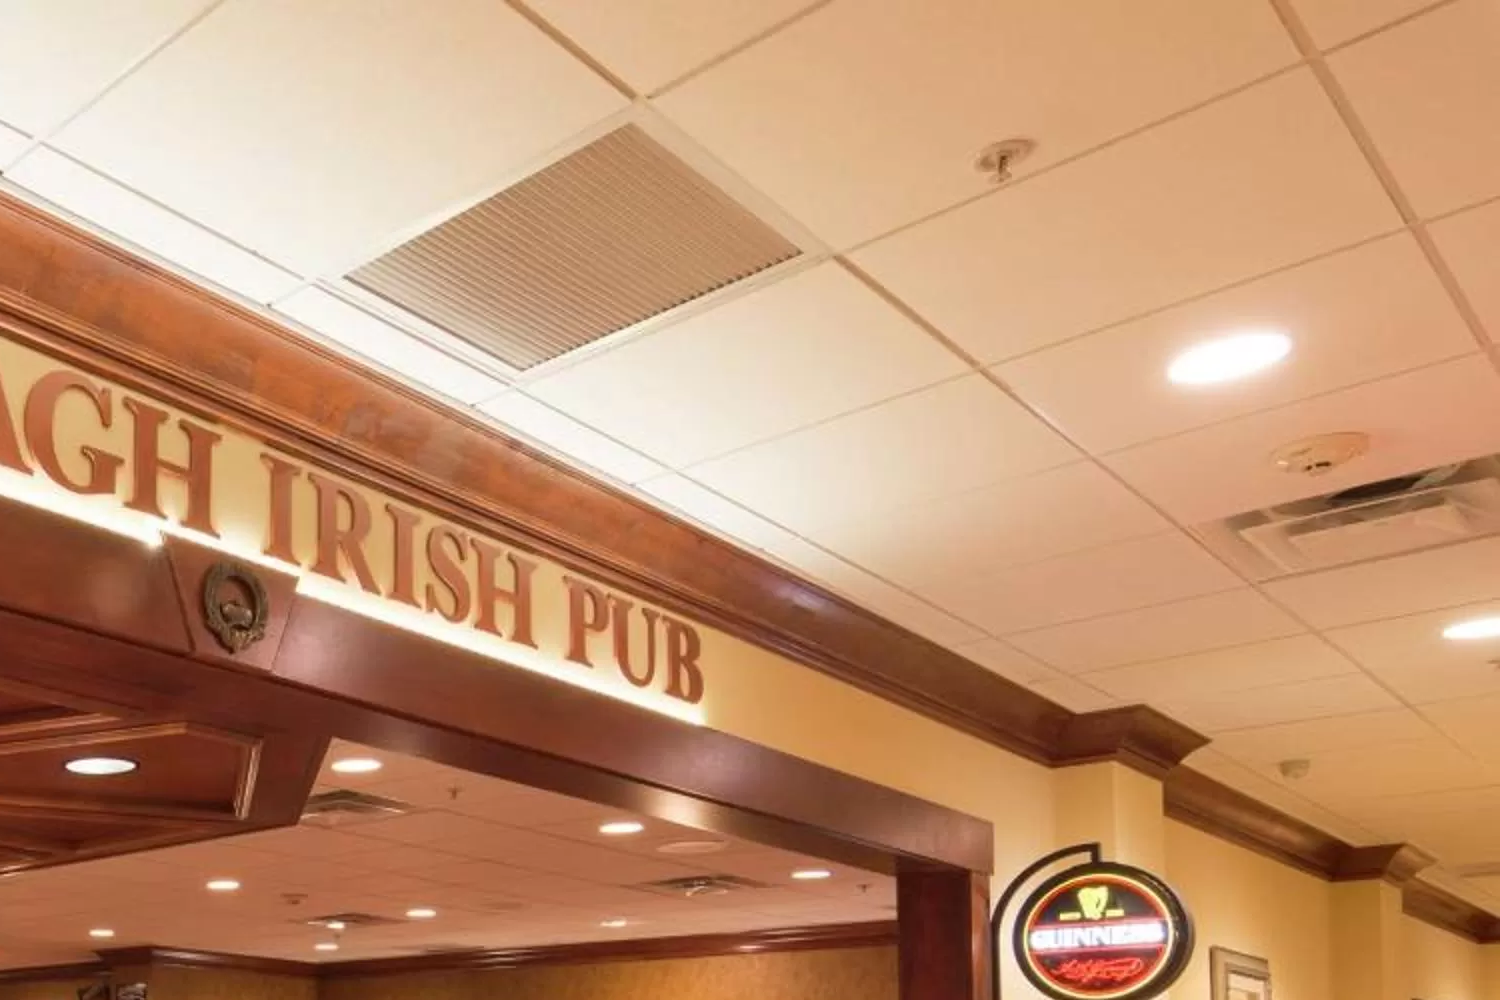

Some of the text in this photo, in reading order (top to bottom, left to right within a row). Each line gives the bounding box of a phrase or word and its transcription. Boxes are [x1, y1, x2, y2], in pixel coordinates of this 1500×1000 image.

[260, 449, 538, 650] IRISH
[561, 573, 705, 704] PUB
[1030, 922, 1164, 950] GUINNE
